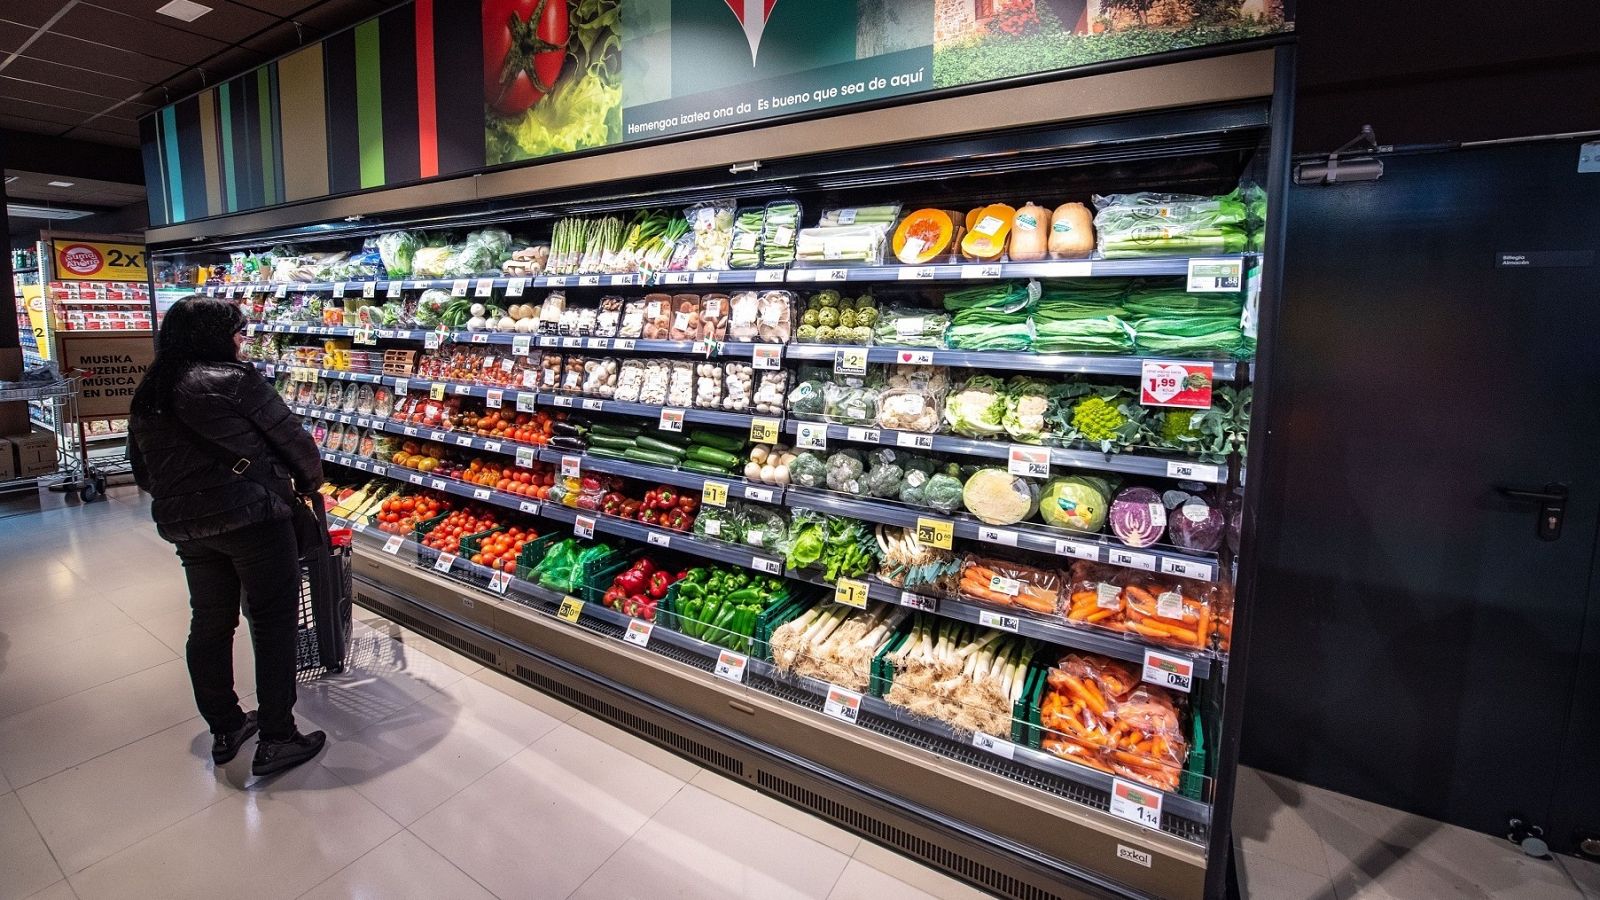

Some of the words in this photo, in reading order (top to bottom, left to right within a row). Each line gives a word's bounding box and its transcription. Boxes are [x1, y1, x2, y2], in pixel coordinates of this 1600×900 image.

[628, 118, 678, 134] Hemengoa
[680, 111, 710, 124] izatea
[713, 107, 733, 119] ona
[736, 103, 751, 114] da
[757, 99, 769, 111] Es
[772, 92, 809, 108] bueno
[813, 87, 838, 102] que
[841, 82, 864, 96] sea
[868, 77, 887, 91] de
[890, 67, 924, 87] aquí
[80, 354, 133, 364] MUSIKA
[82, 375, 136, 387] MÚSICA
[1149, 378, 1176, 392] 1,99
[83, 389, 100, 398] EN
[104, 387, 135, 397] DIRE
[1119, 847, 1148, 863] exkal
